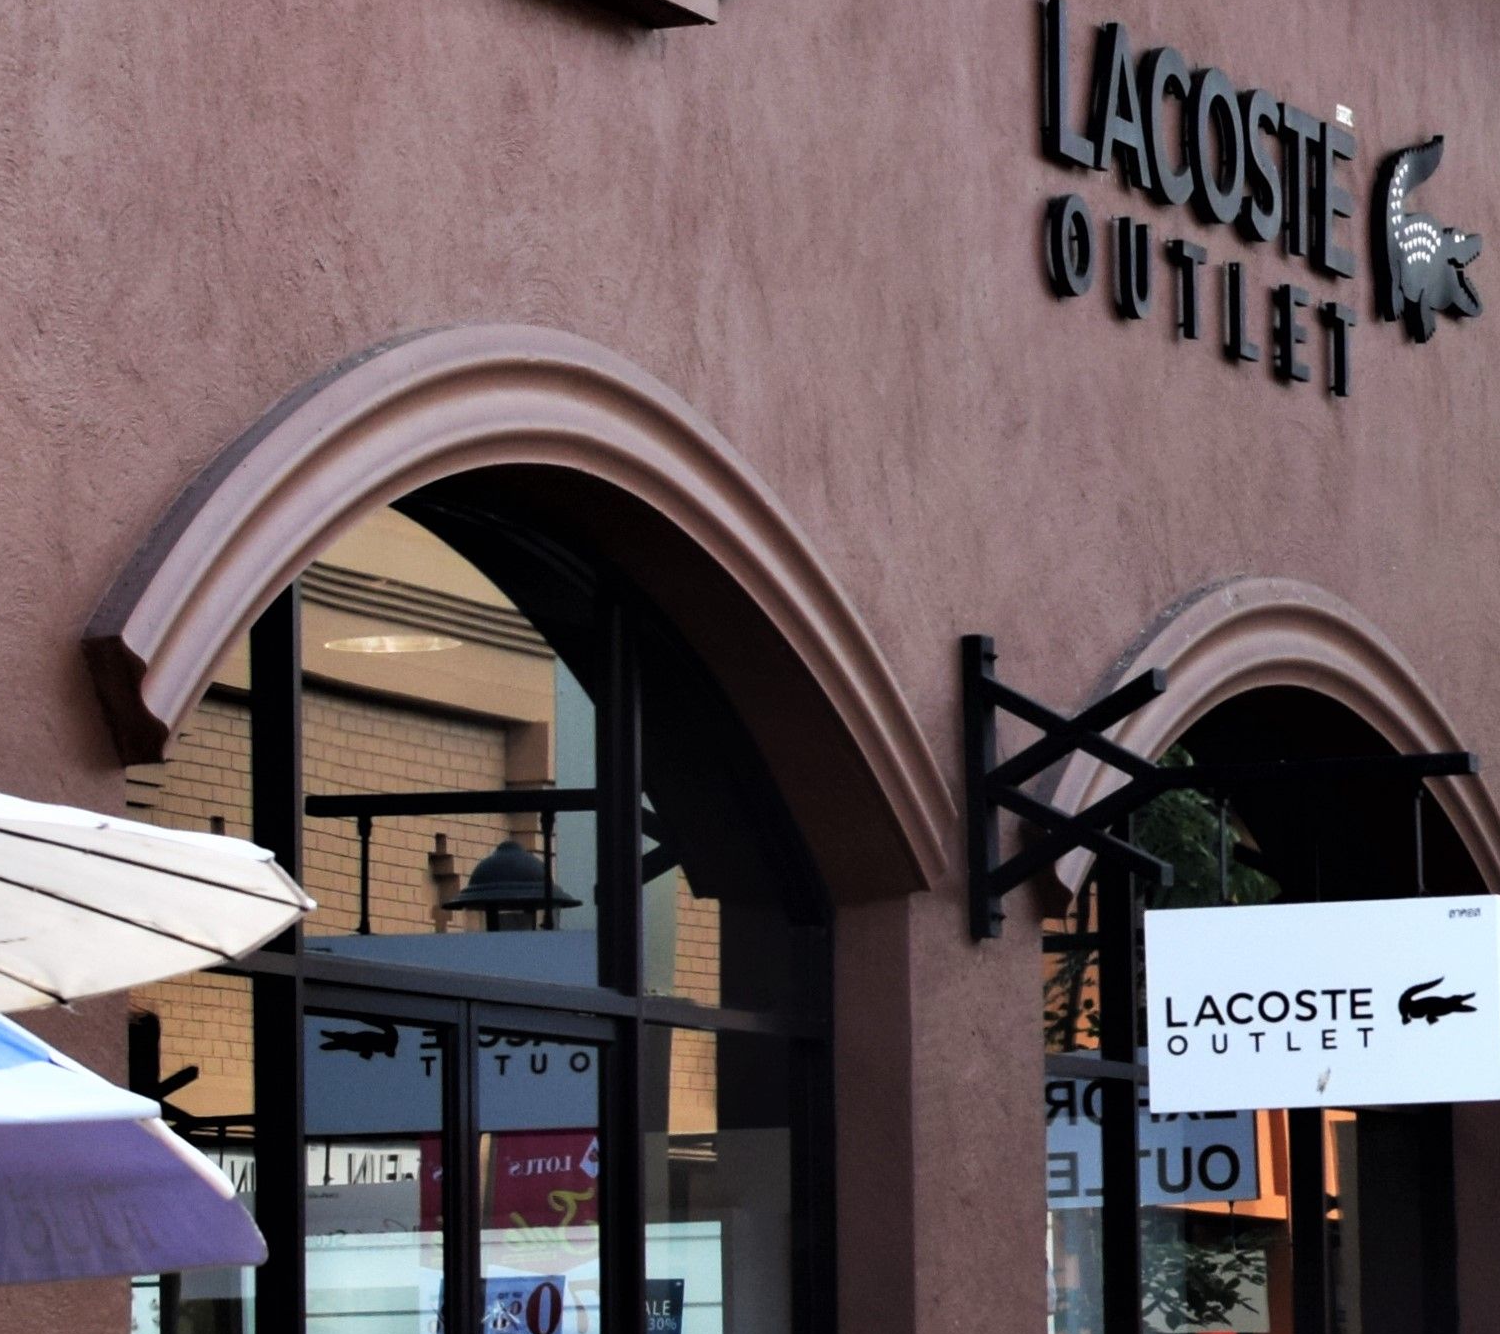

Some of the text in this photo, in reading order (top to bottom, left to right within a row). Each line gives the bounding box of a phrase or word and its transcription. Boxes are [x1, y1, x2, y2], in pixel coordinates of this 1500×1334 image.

[1048, 193, 1358, 398] OUTLET
[1165, 987, 1374, 1028] LACOSTE
[1166, 1026, 1376, 1057] OUTLET
